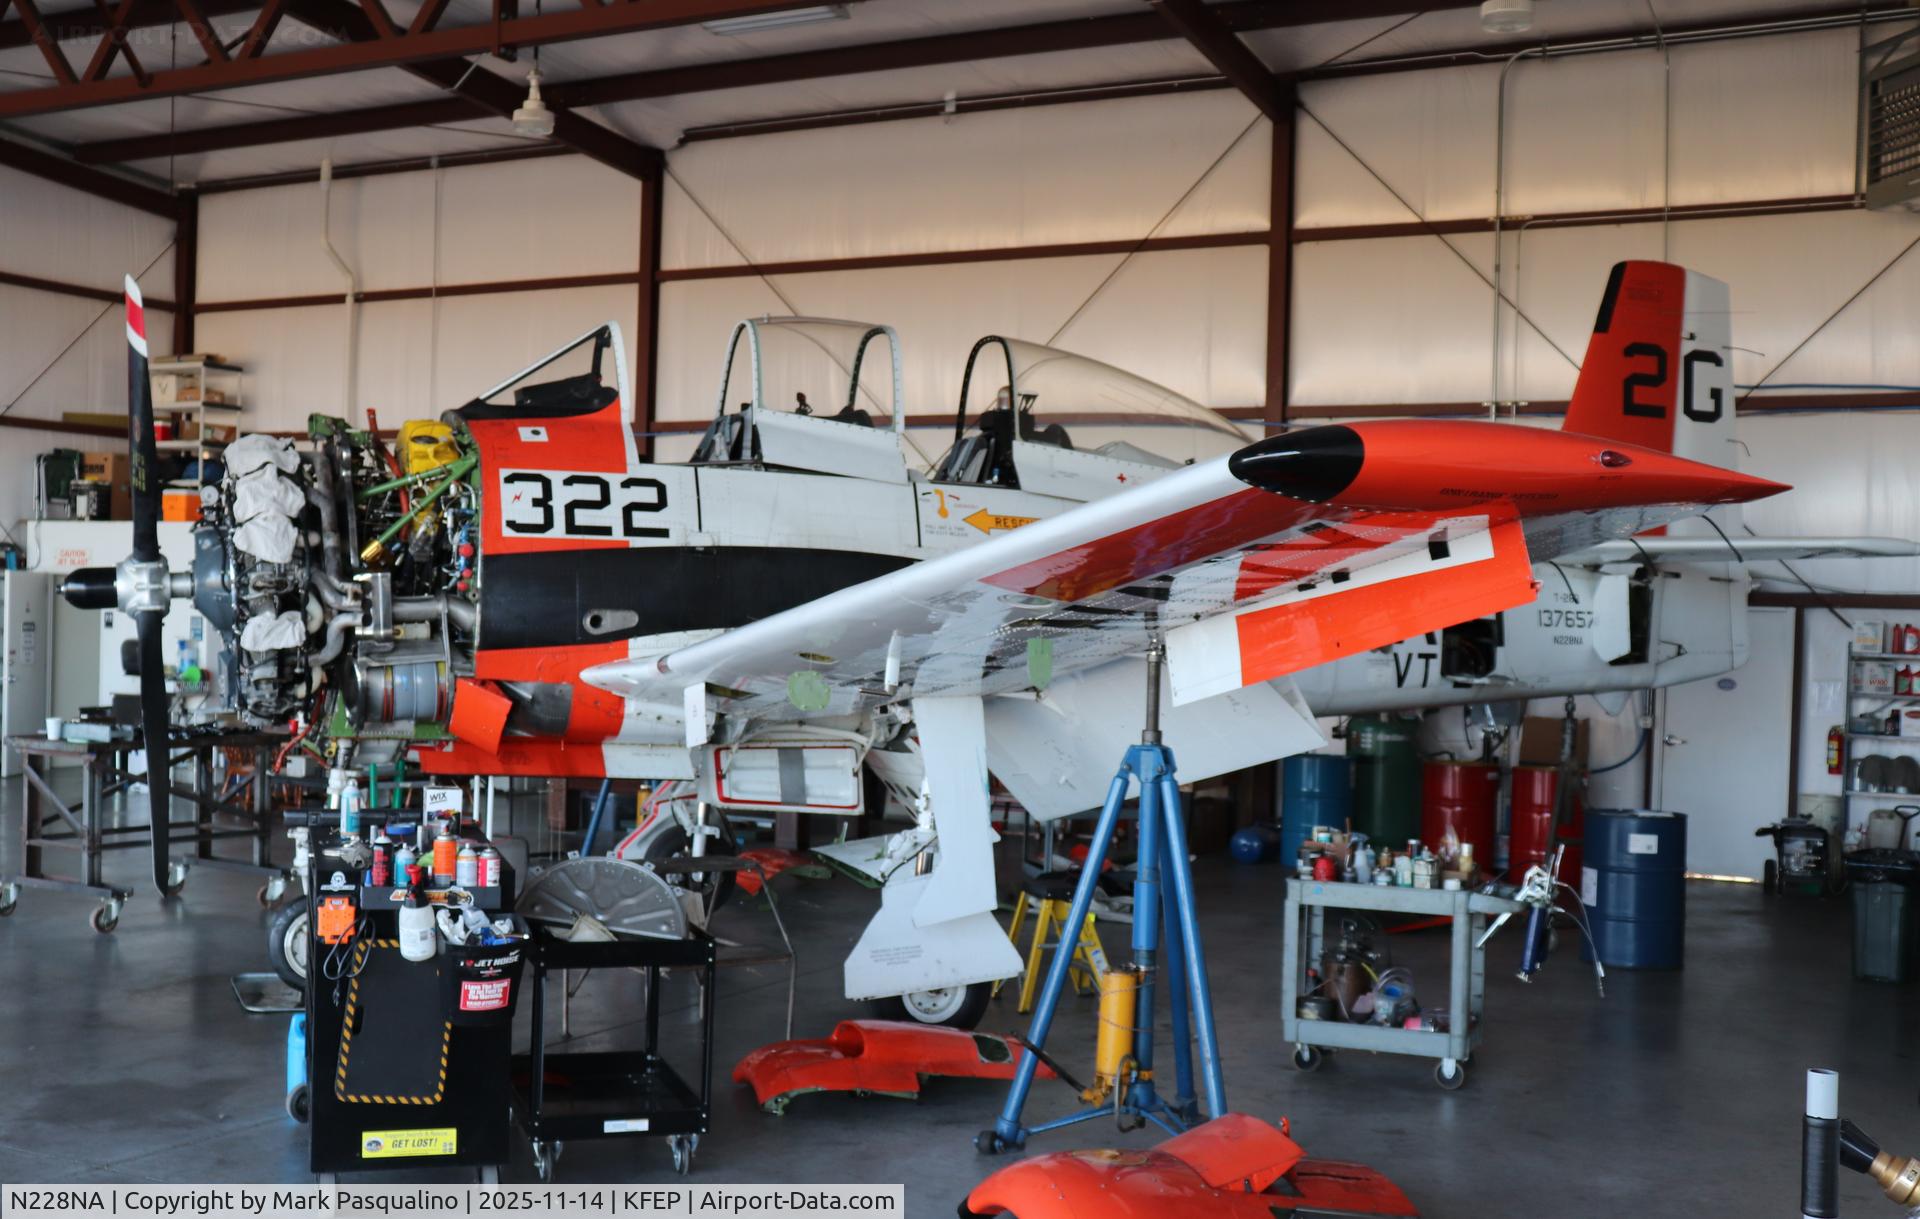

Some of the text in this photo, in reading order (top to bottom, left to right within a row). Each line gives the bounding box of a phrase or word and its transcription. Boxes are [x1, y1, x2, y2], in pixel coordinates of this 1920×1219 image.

[504, 472, 670, 539] 322
[1538, 609, 1594, 629] 137657
[1553, 635, 1584, 645] N228NA
[429, 792, 448, 801] WIX
[474, 959, 494, 967] JET
[494, 954, 520, 966] NOISE
[392, 1138, 438, 1149] GET LOST!
